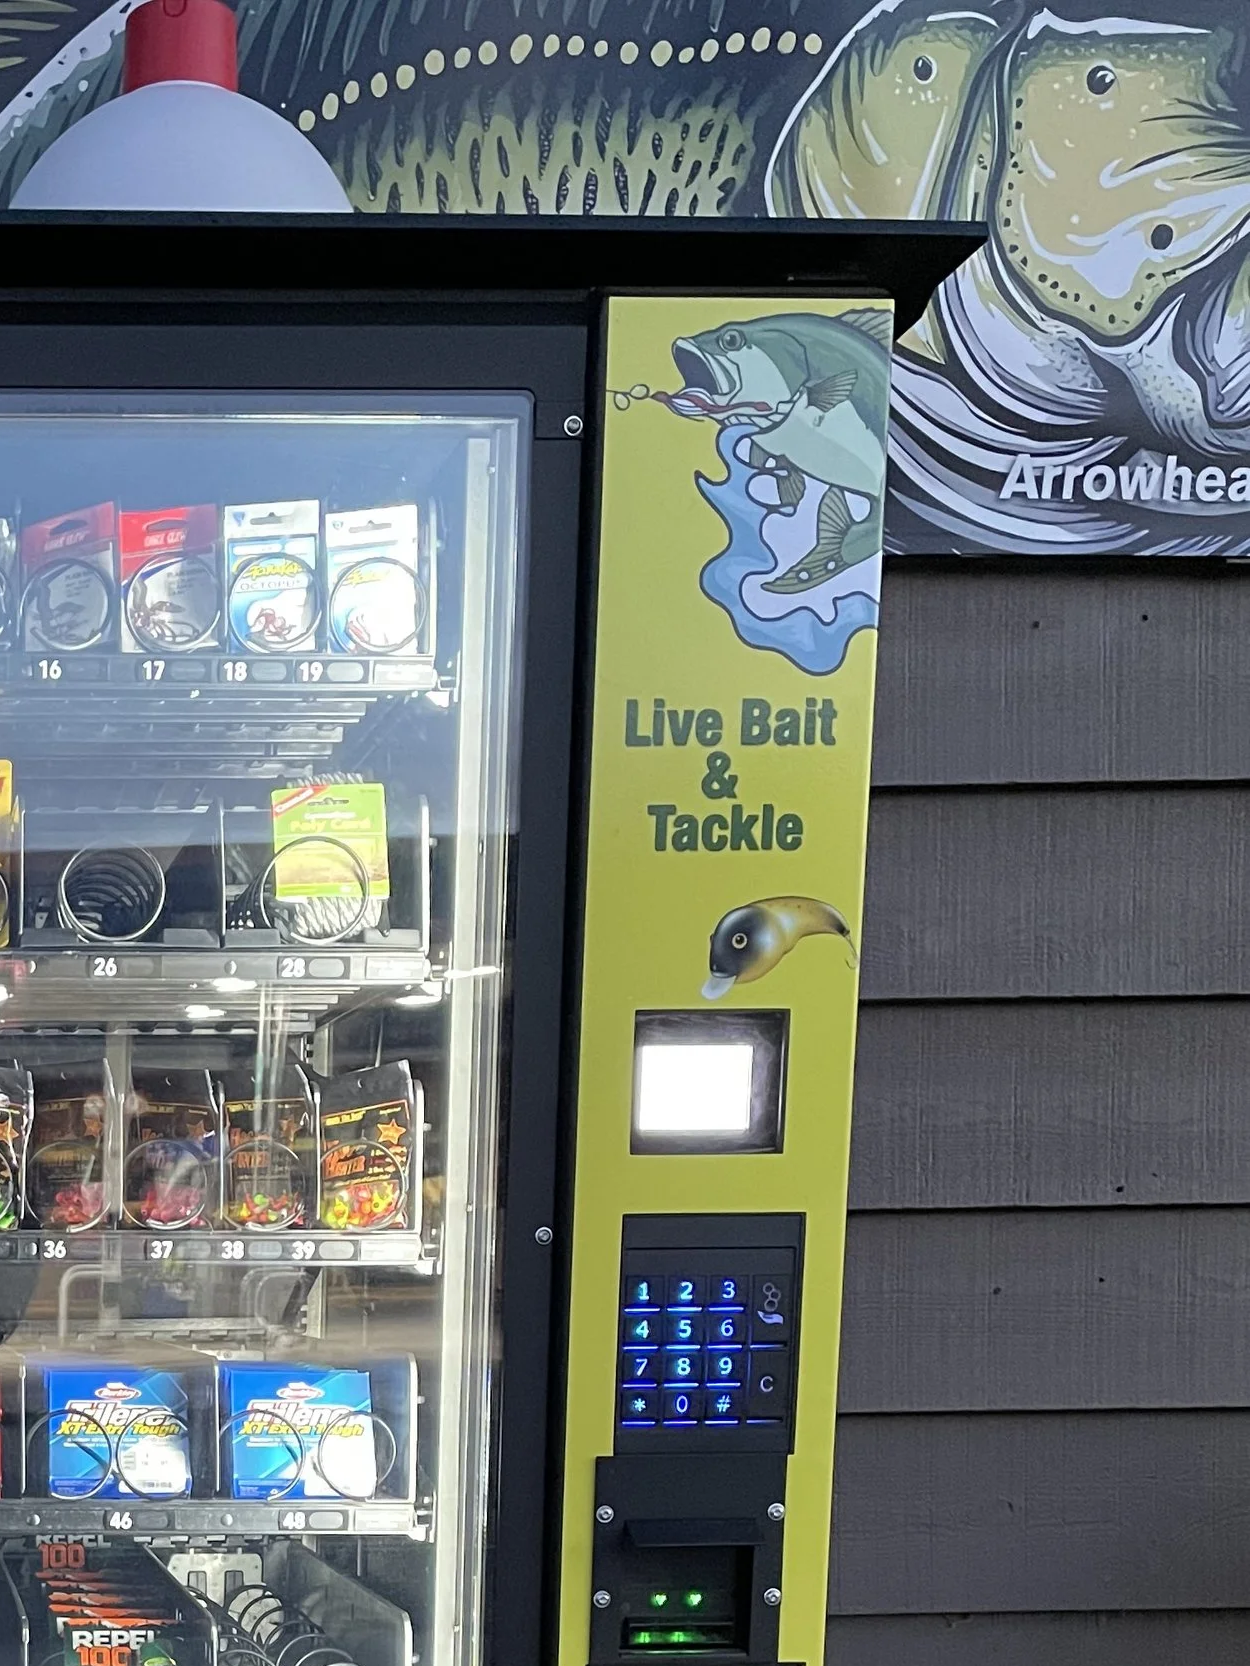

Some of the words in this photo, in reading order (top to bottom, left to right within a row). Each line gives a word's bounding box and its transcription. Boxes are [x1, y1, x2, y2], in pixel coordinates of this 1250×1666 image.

[39, 660, 62, 679] 16
[142, 660, 165, 680] 17
[223, 661, 247, 681] 18
[299, 661, 323, 681] 19
[625, 698, 723, 747] Live
[740, 697, 838, 746] Bait
[701, 751, 738, 800] &
[647, 804, 804, 852] Tackle
[93, 958, 118, 977] 26
[281, 958, 305, 978] 28
[43, 1240, 67, 1258] 36
[150, 1240, 174, 1259] 37
[221, 1241, 245, 1259] 38
[291, 1241, 316, 1260] 39
[639, 1282, 650, 1300] 1
[680, 1281, 693, 1300] 2
[722, 1281, 735, 1299] 3
[635, 1320, 649, 1338] 4
[679, 1319, 692, 1337] 5
[721, 1319, 733, 1336] 6
[635, 1358, 648, 1376] 7
[677, 1358, 691, 1375] 8
[719, 1357, 733, 1375] 9
[760, 1376, 774, 1392] C
[716, 1395, 731, 1413] #
[109, 1512, 133, 1530] 46
[283, 1512, 305, 1530] 48
[38, 1543, 85, 1569] 100
